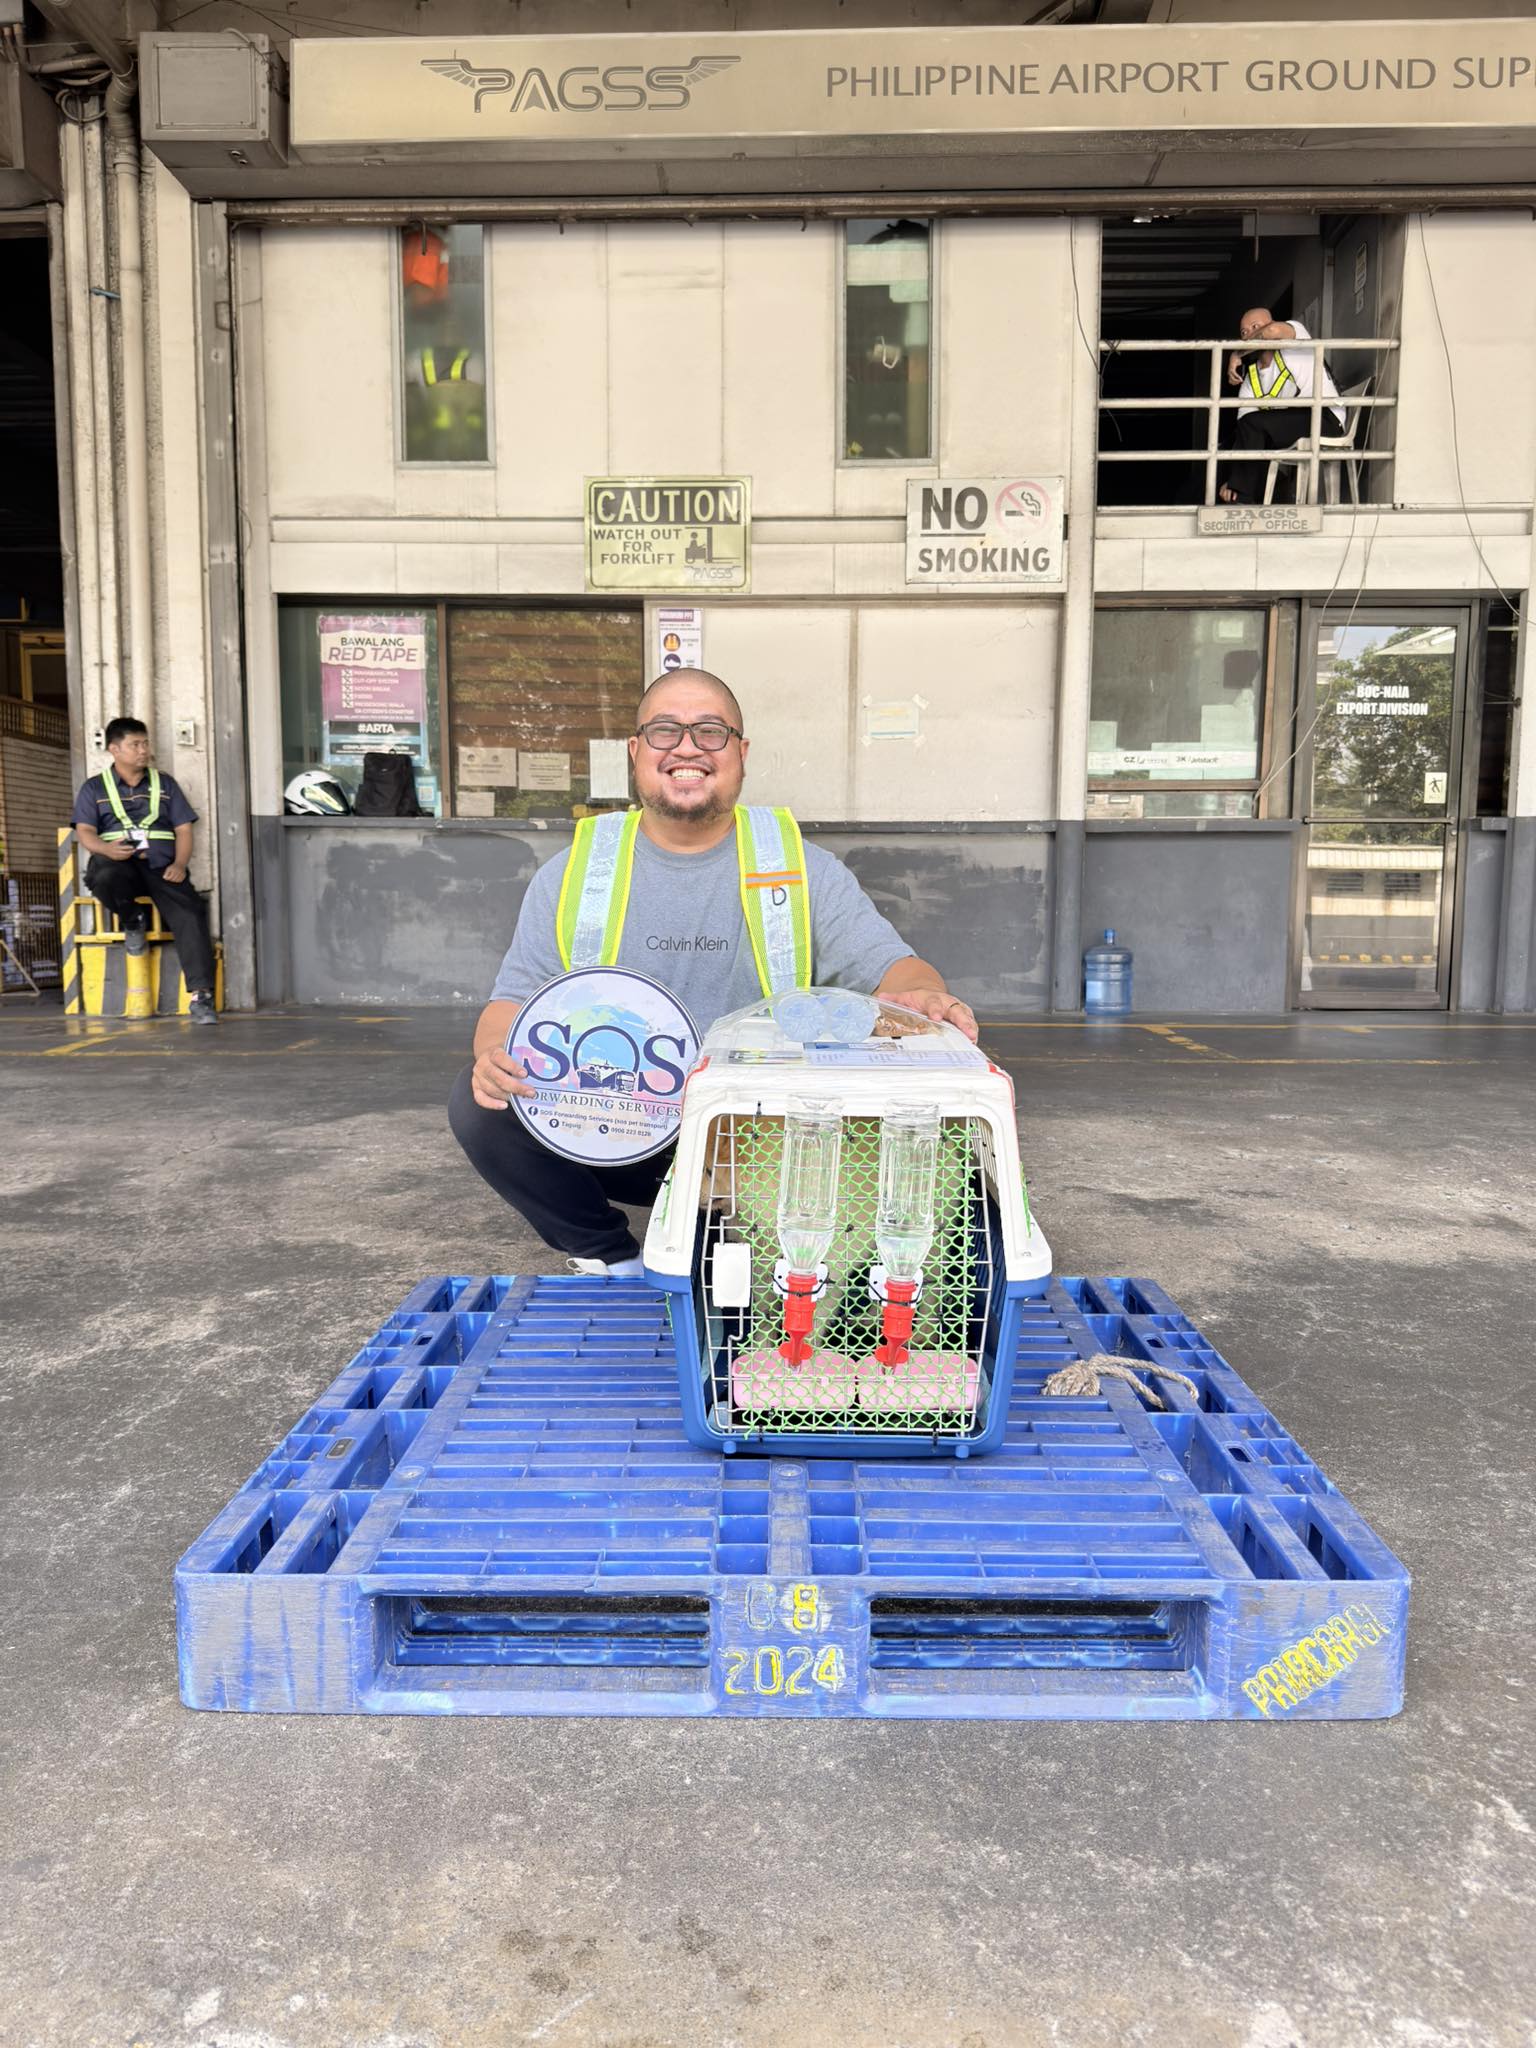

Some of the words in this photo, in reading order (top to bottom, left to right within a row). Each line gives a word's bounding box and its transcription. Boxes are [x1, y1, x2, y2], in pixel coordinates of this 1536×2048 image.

[826, 64, 1041, 98] PHILIPPINE
[1048, 61, 1230, 95] AIRPORT
[1245, 58, 1437, 92] GROUND
[1452, 55, 1536, 90] SUP
[460, 58, 704, 113] PAGSS
[596, 489, 739, 523] CAUTION
[921, 486, 988, 531] NO
[1224, 508, 1299, 520] PAGSS
[1203, 520, 1254, 531] SECURITY
[1265, 519, 1308, 530] OFFICE
[593, 528, 645, 540] WATCH
[650, 528, 682, 540] OUT
[623, 541, 653, 553] FOR
[600, 553, 675, 565] FORKLIFT
[917, 547, 1051, 574] SMOKING
[340, 637, 378, 647] BAWAL
[380, 637, 405, 647] ANG
[328, 647, 366, 661] RED
[370, 647, 418, 662] TAPE
[1357, 685, 1410, 699] BOC-NAIA
[1336, 702, 1377, 716] EXPORT
[1379, 702, 1429, 716] DIVISION
[357, 722, 396, 734] #ARTA
[646, 935, 692, 951] Calvin
[694, 935, 729, 951] Klein
[523, 1020, 687, 1097] SOS
[533, 1089, 614, 1110] ORWARDING
[618, 1101, 681, 1118] SERVICES
[554, 1111, 587, 1122] Forwarding
[588, 1114, 613, 1124] Services
[719, 1644, 846, 1696] 2024
